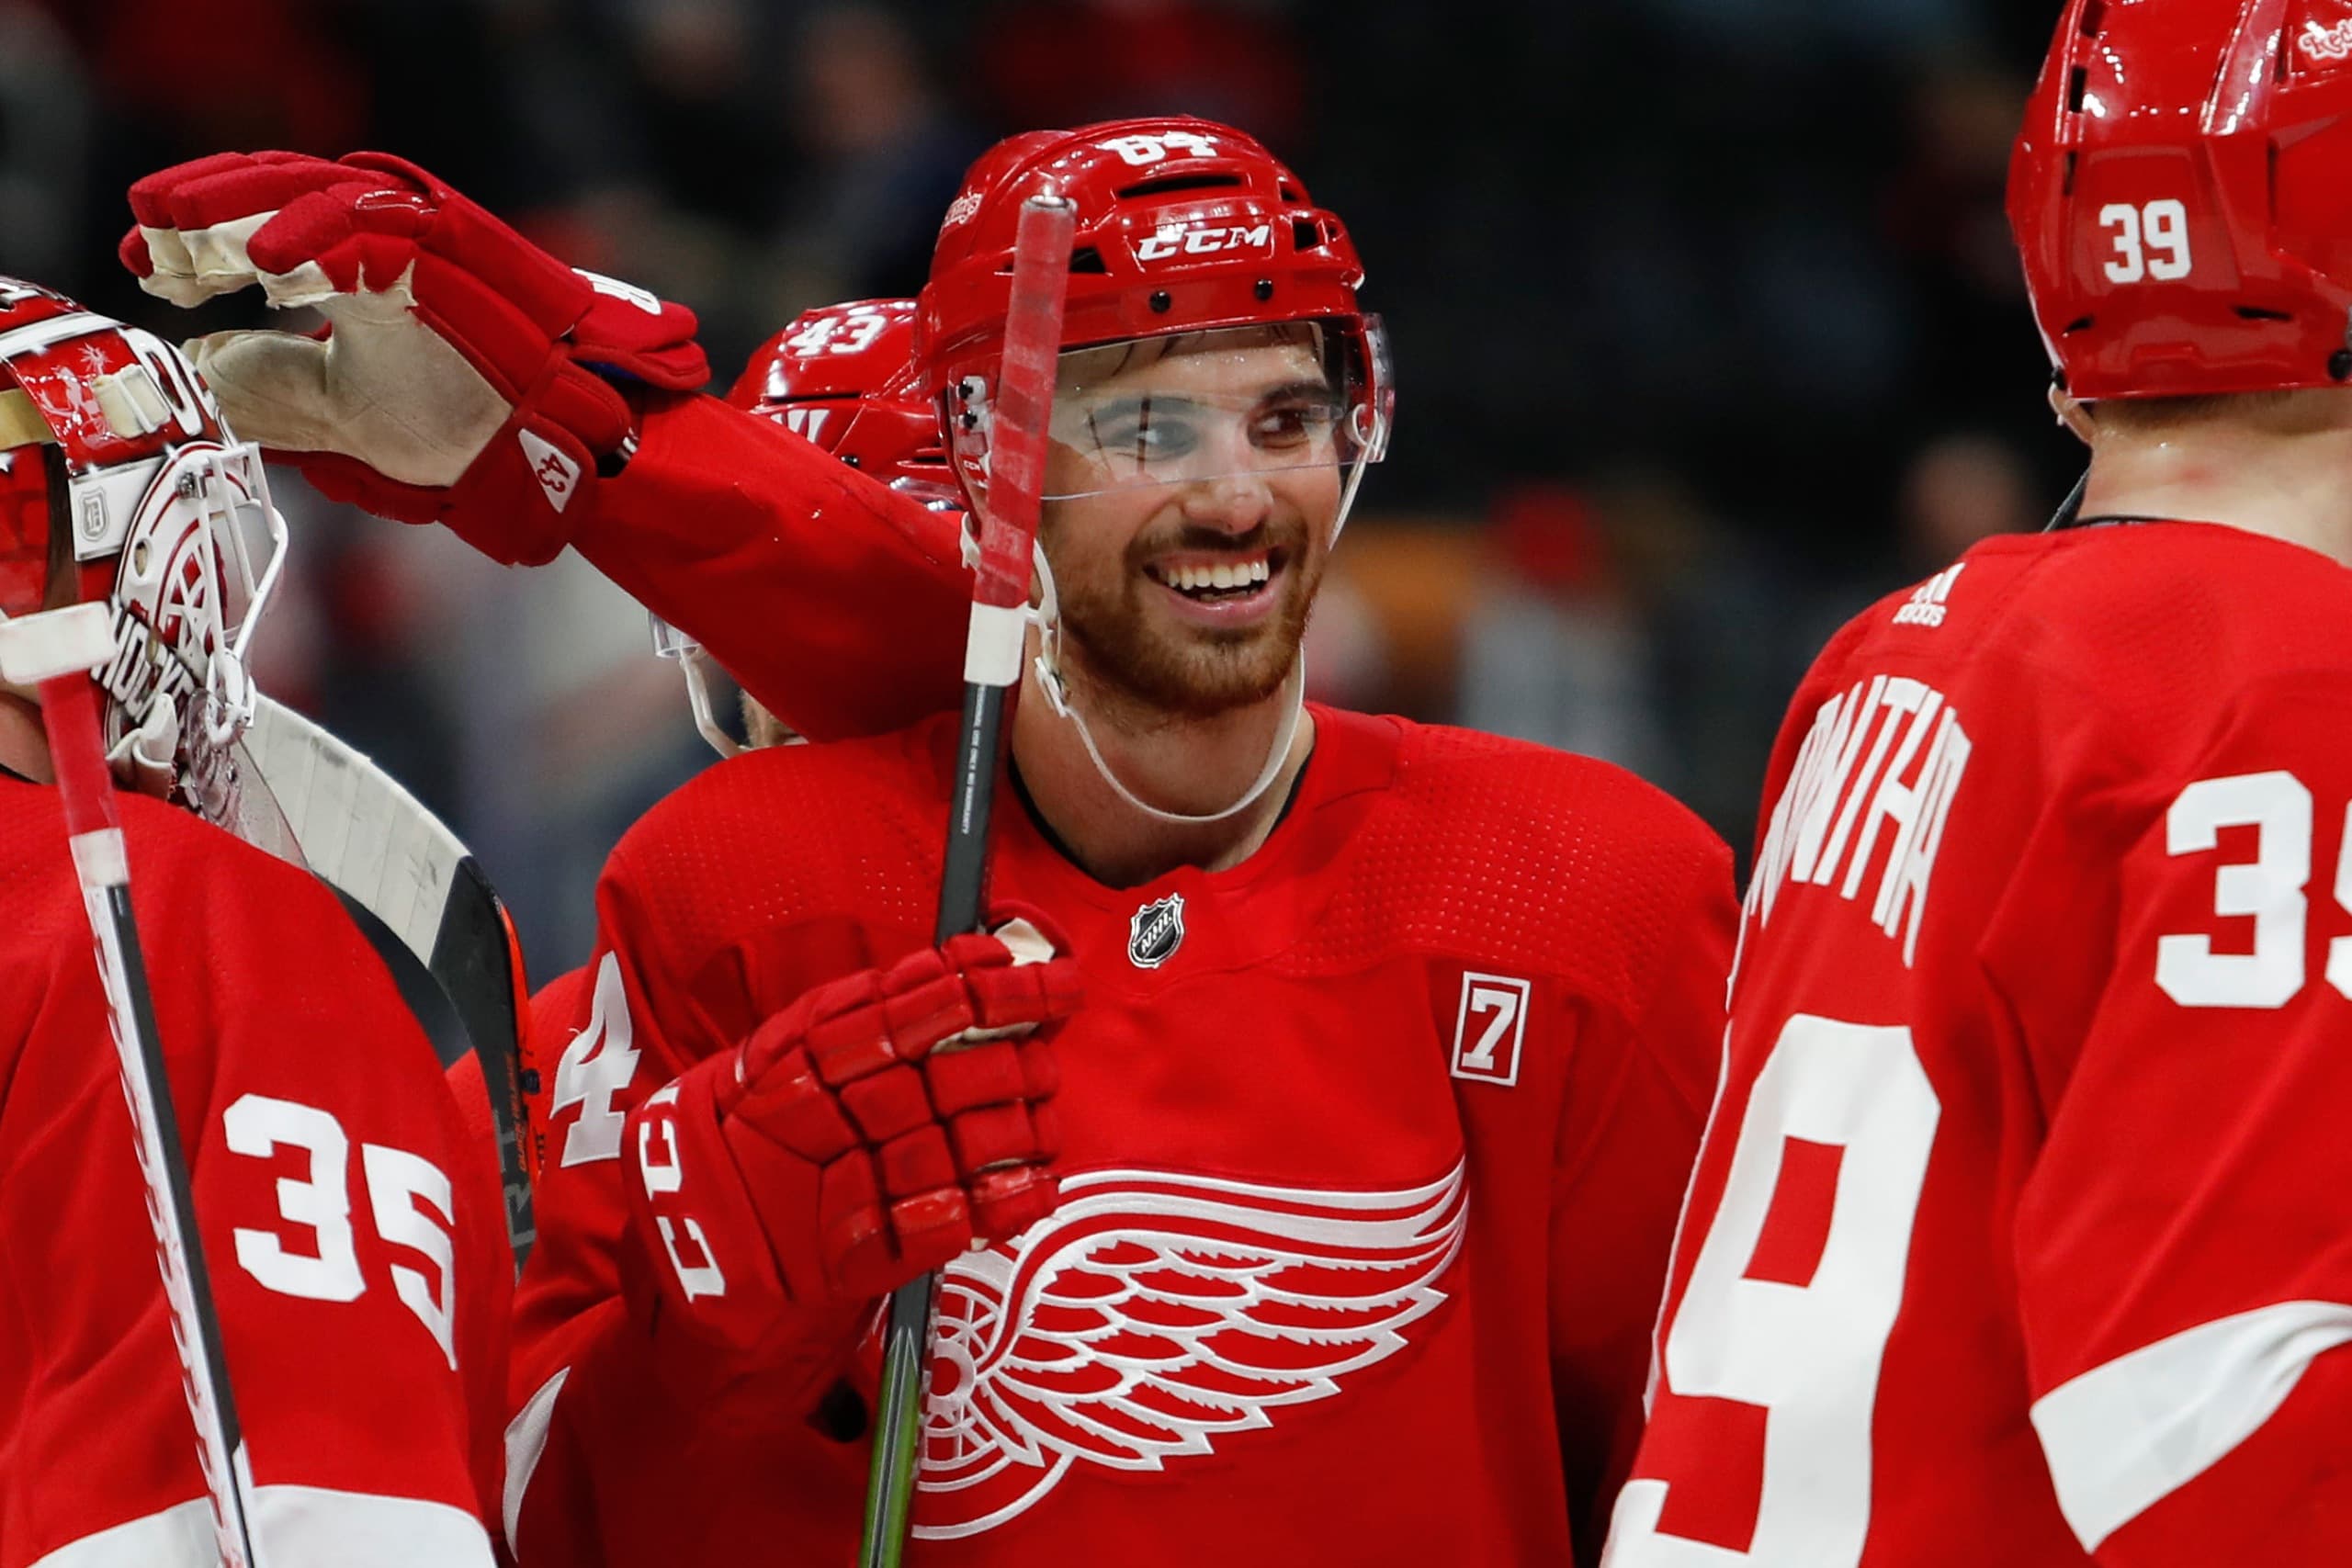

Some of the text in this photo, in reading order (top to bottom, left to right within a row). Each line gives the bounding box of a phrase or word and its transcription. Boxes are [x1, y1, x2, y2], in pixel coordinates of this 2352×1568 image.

[1114, 130, 1218, 165] 84
[1137, 225, 1270, 261] CCM
[2098, 198, 2192, 284] 39
[786, 315, 888, 356] 43
[537, 453, 571, 493] 43
[2154, 769, 2352, 1010] 3
[1141, 912, 1172, 953] NHL
[1462, 987, 1519, 1070] 7
[222, 1092, 459, 1371] 35
[1599, 1012, 1942, 1568] 9
